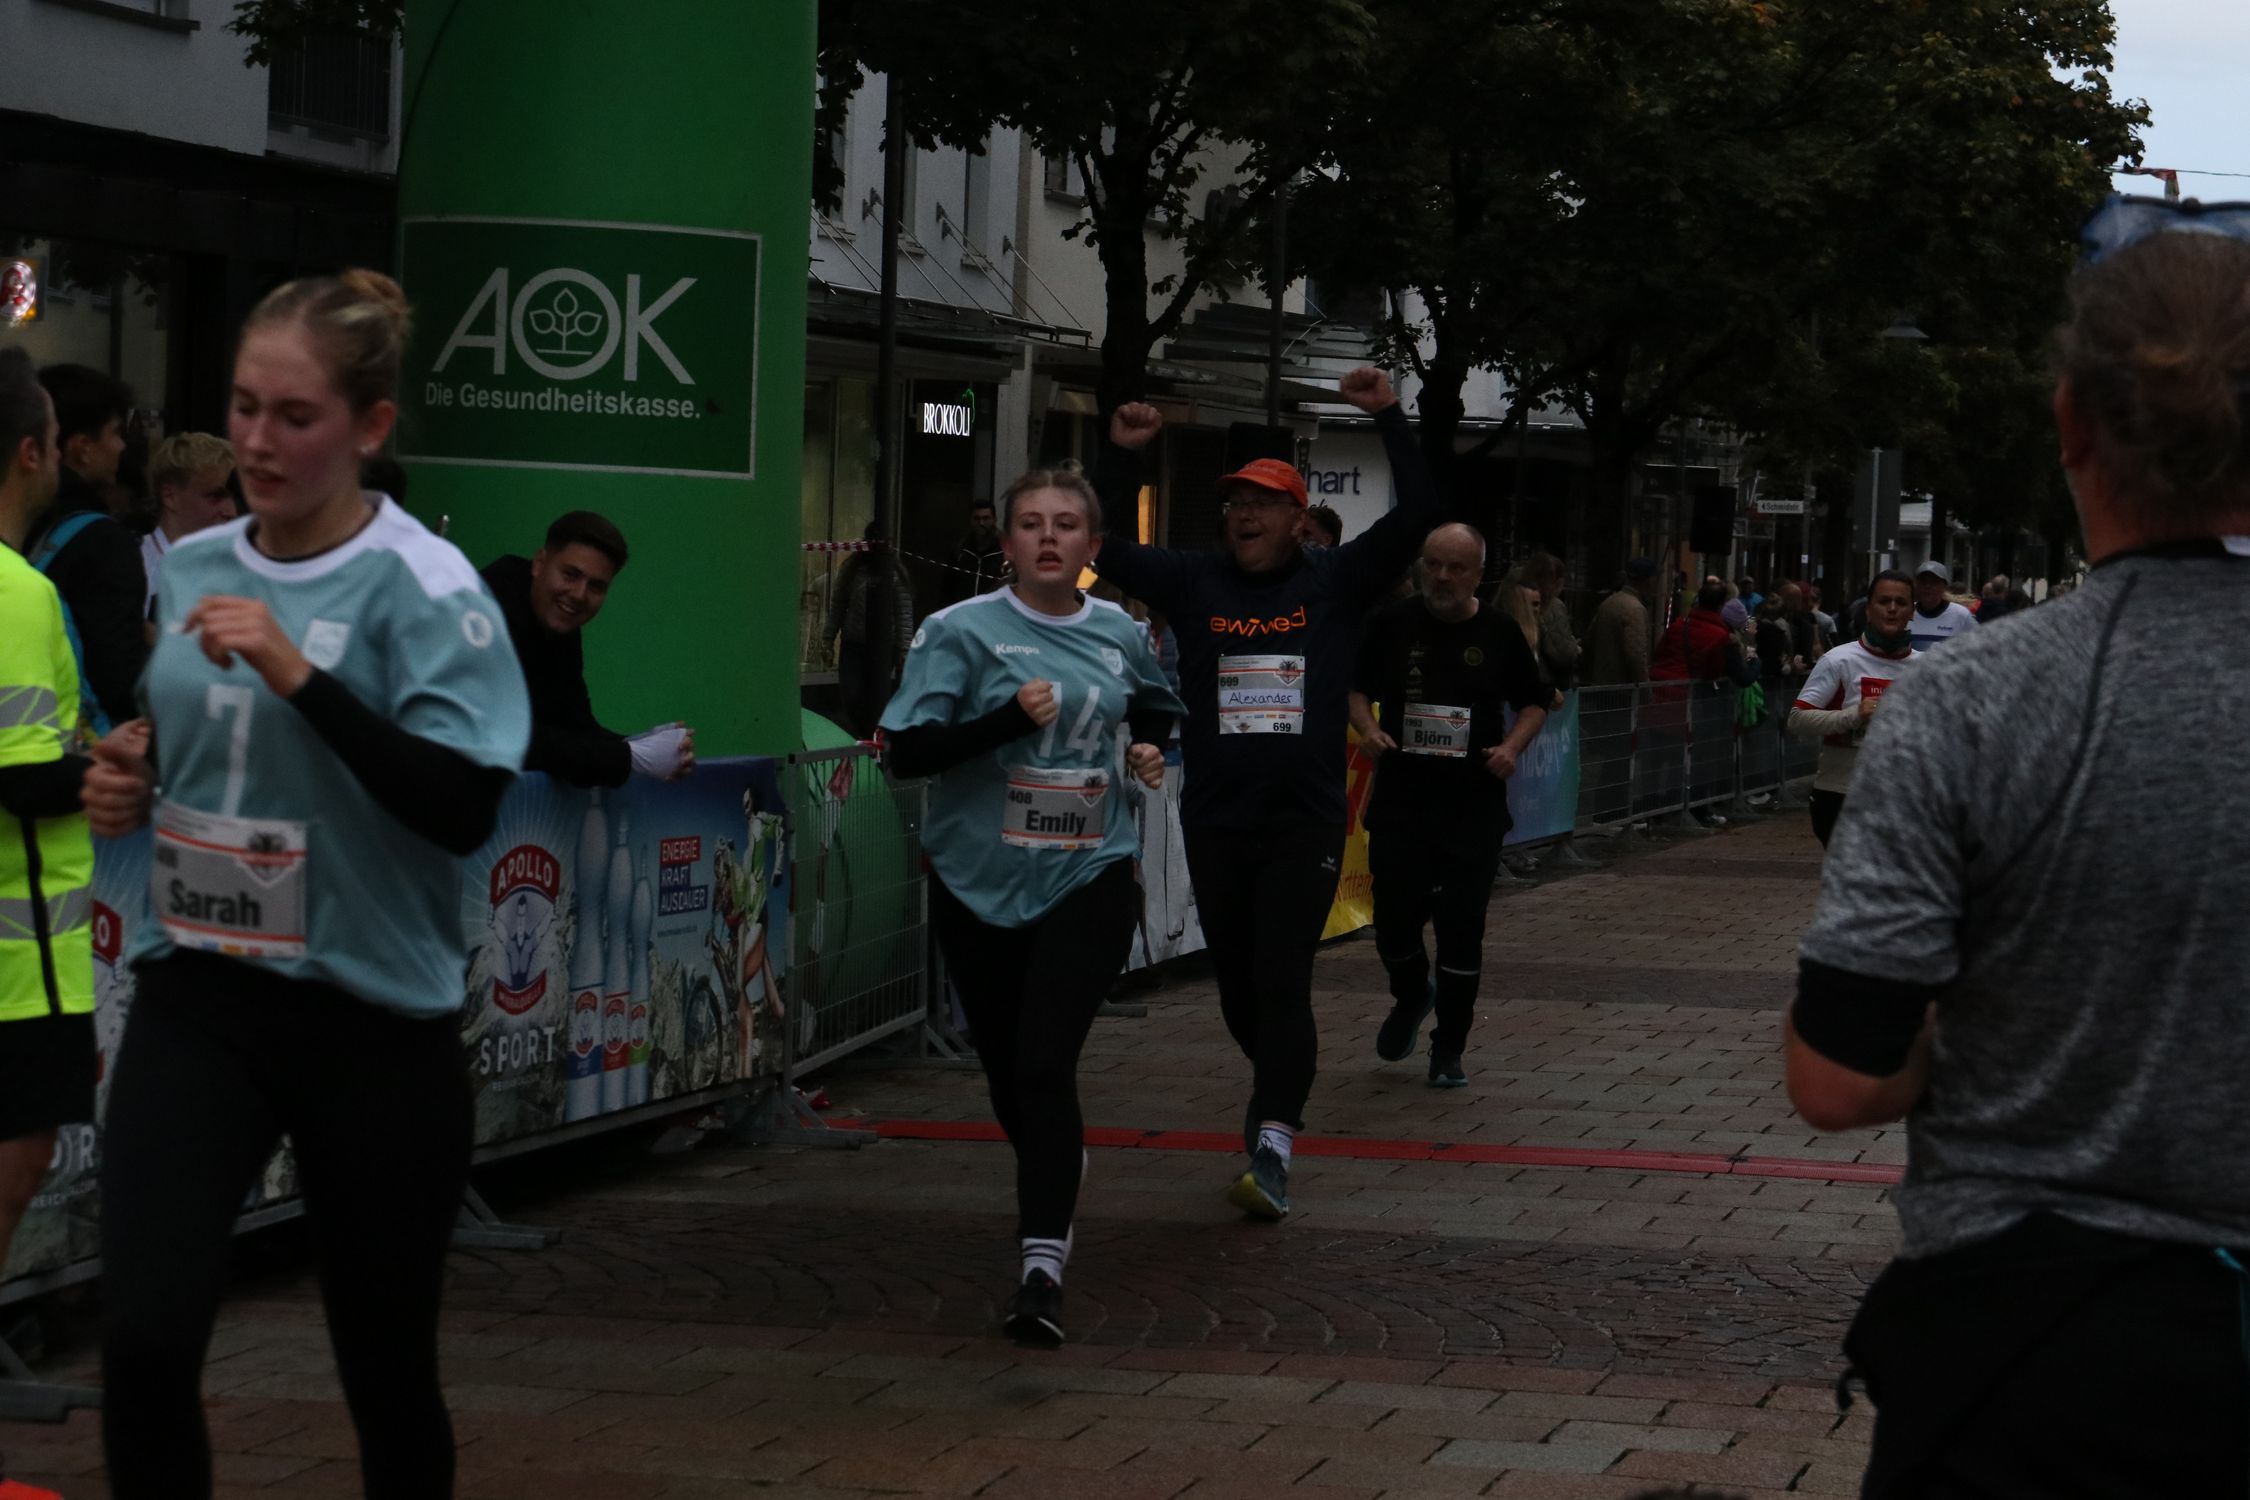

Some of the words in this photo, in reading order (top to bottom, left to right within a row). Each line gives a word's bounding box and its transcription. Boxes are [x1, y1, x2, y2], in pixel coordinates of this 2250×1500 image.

[431, 267, 699, 385] AOK
[425, 381, 454, 406] Die
[460, 382, 701, 419] Gesundheitskasse.
[923, 402, 970, 437] BROKKOLI
[1304, 463, 1361, 495] hart
[995, 643, 1040, 656] Kempa
[1220, 676, 1239, 687] 699
[1228, 691, 1293, 705] Alexander
[1273, 722, 1291, 732] 699
[1414, 730, 1452, 747] Björn
[206, 684, 255, 818] 7
[1007, 789, 1033, 804] 408
[1025, 809, 1087, 836] Emily
[496, 851, 553, 896] APOLLO
[661, 865, 689, 886] KRAFT
[169, 878, 262, 928] Sarah
[661, 888, 706, 912] AUSDAUER
[479, 1026, 557, 1076] SPORT
